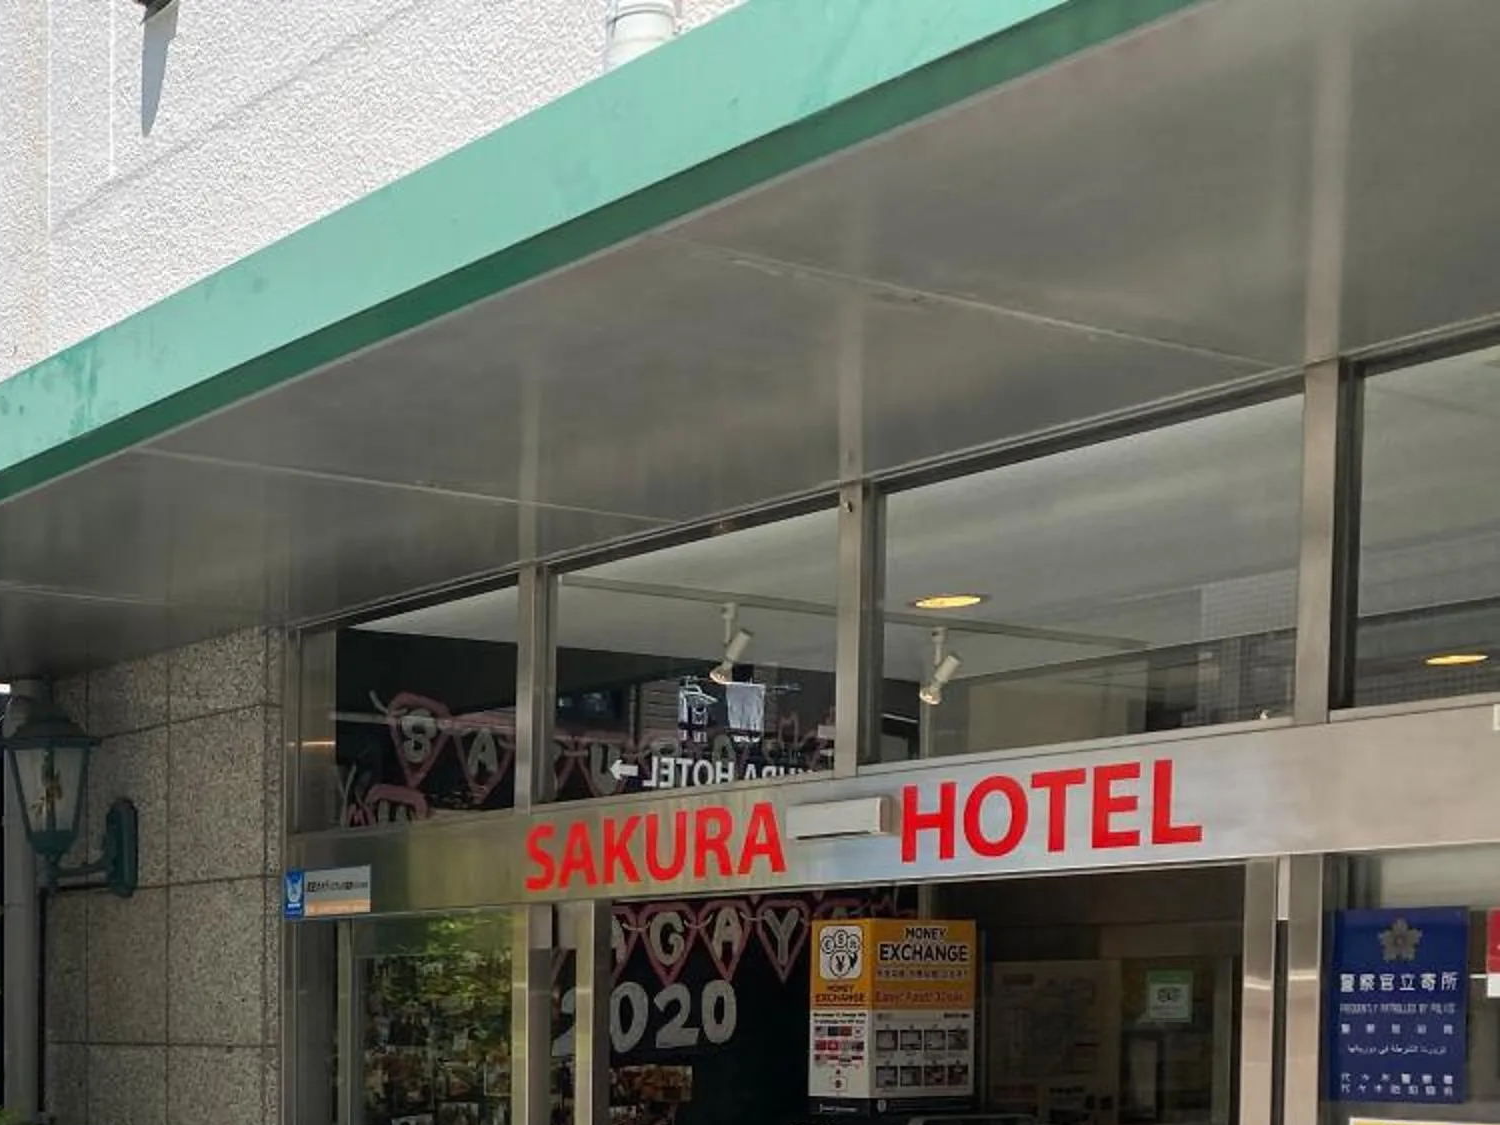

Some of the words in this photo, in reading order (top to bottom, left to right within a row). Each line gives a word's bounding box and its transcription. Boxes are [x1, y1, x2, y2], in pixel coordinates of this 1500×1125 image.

[525, 802, 787, 891] SAKURA
[902, 759, 1204, 864] HOTEL
[905, 927, 948, 941] MONEY
[879, 944, 969, 962] EXCHANGE
